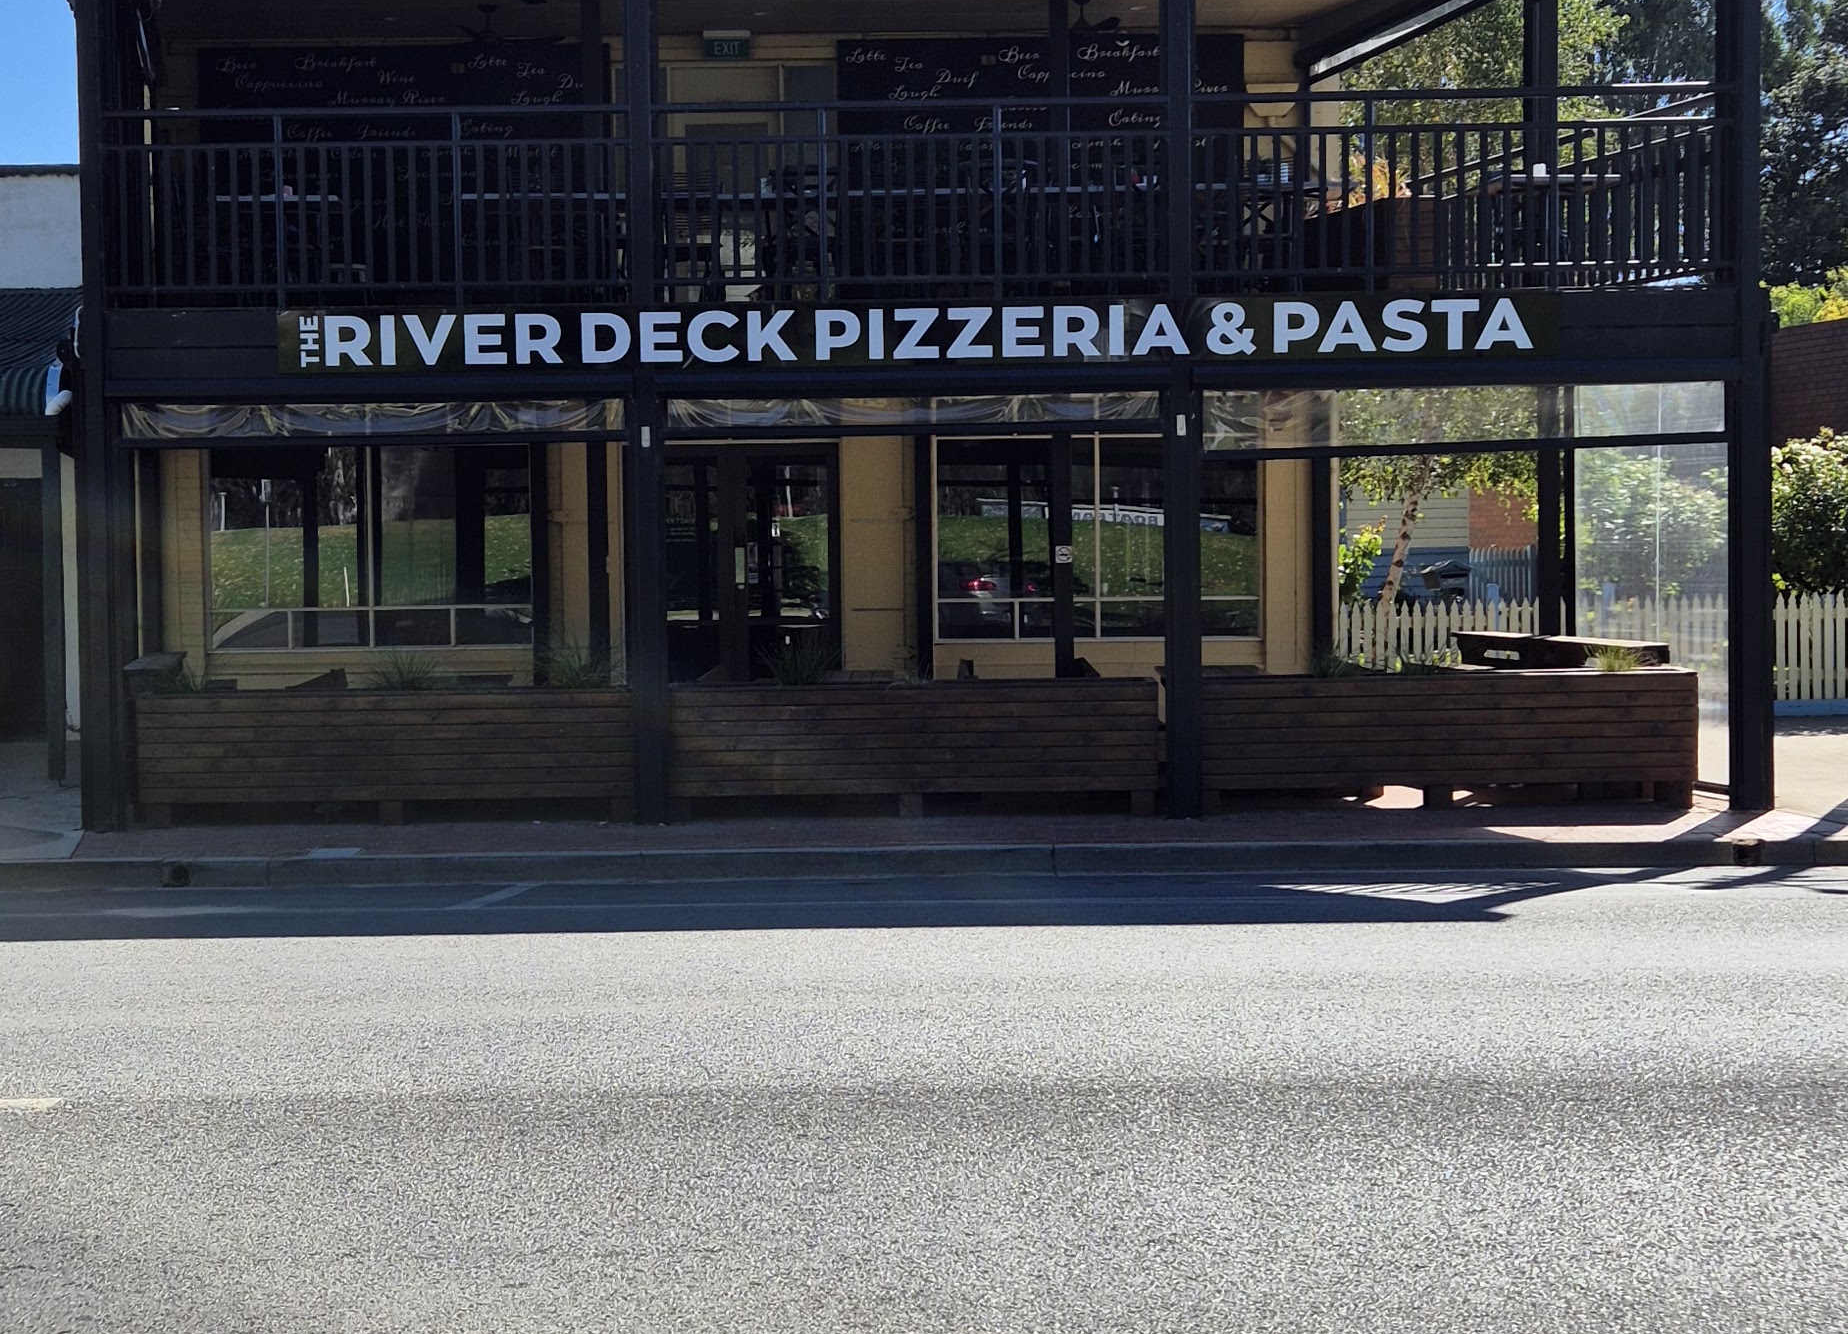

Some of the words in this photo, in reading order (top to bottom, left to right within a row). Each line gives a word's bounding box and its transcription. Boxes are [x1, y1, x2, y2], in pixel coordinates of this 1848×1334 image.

[713, 40, 740, 55] EXIT
[845, 48, 887, 64] Latte
[998, 46, 1040, 65] Beer
[1077, 43, 1161, 63] Breakfast
[215, 55, 258, 74] Beer
[295, 53, 378, 74] Breakfast
[467, 53, 507, 69] Latte
[516, 61, 545, 79] Tea
[894, 56, 925, 74] Tea
[235, 74, 324, 93] Cappuccino
[377, 69, 415, 85] Wine
[1017, 64, 1106, 84] Cappcino
[328, 90, 396, 108] Murray
[402, 90, 446, 106] River
[511, 90, 564, 106] Laugh
[888, 84, 942, 101] Laugh
[286, 122, 335, 142] Coffee
[460, 118, 514, 138] Eating
[903, 114, 951, 134] Coffee
[298, 314, 321, 368] THE
[323, 313, 565, 367] RIVER
[580, 310, 800, 364] DECK
[814, 303, 1191, 361] PIZZERIA
[1205, 302, 1257, 356] &
[1272, 297, 1535, 353] PASTA
